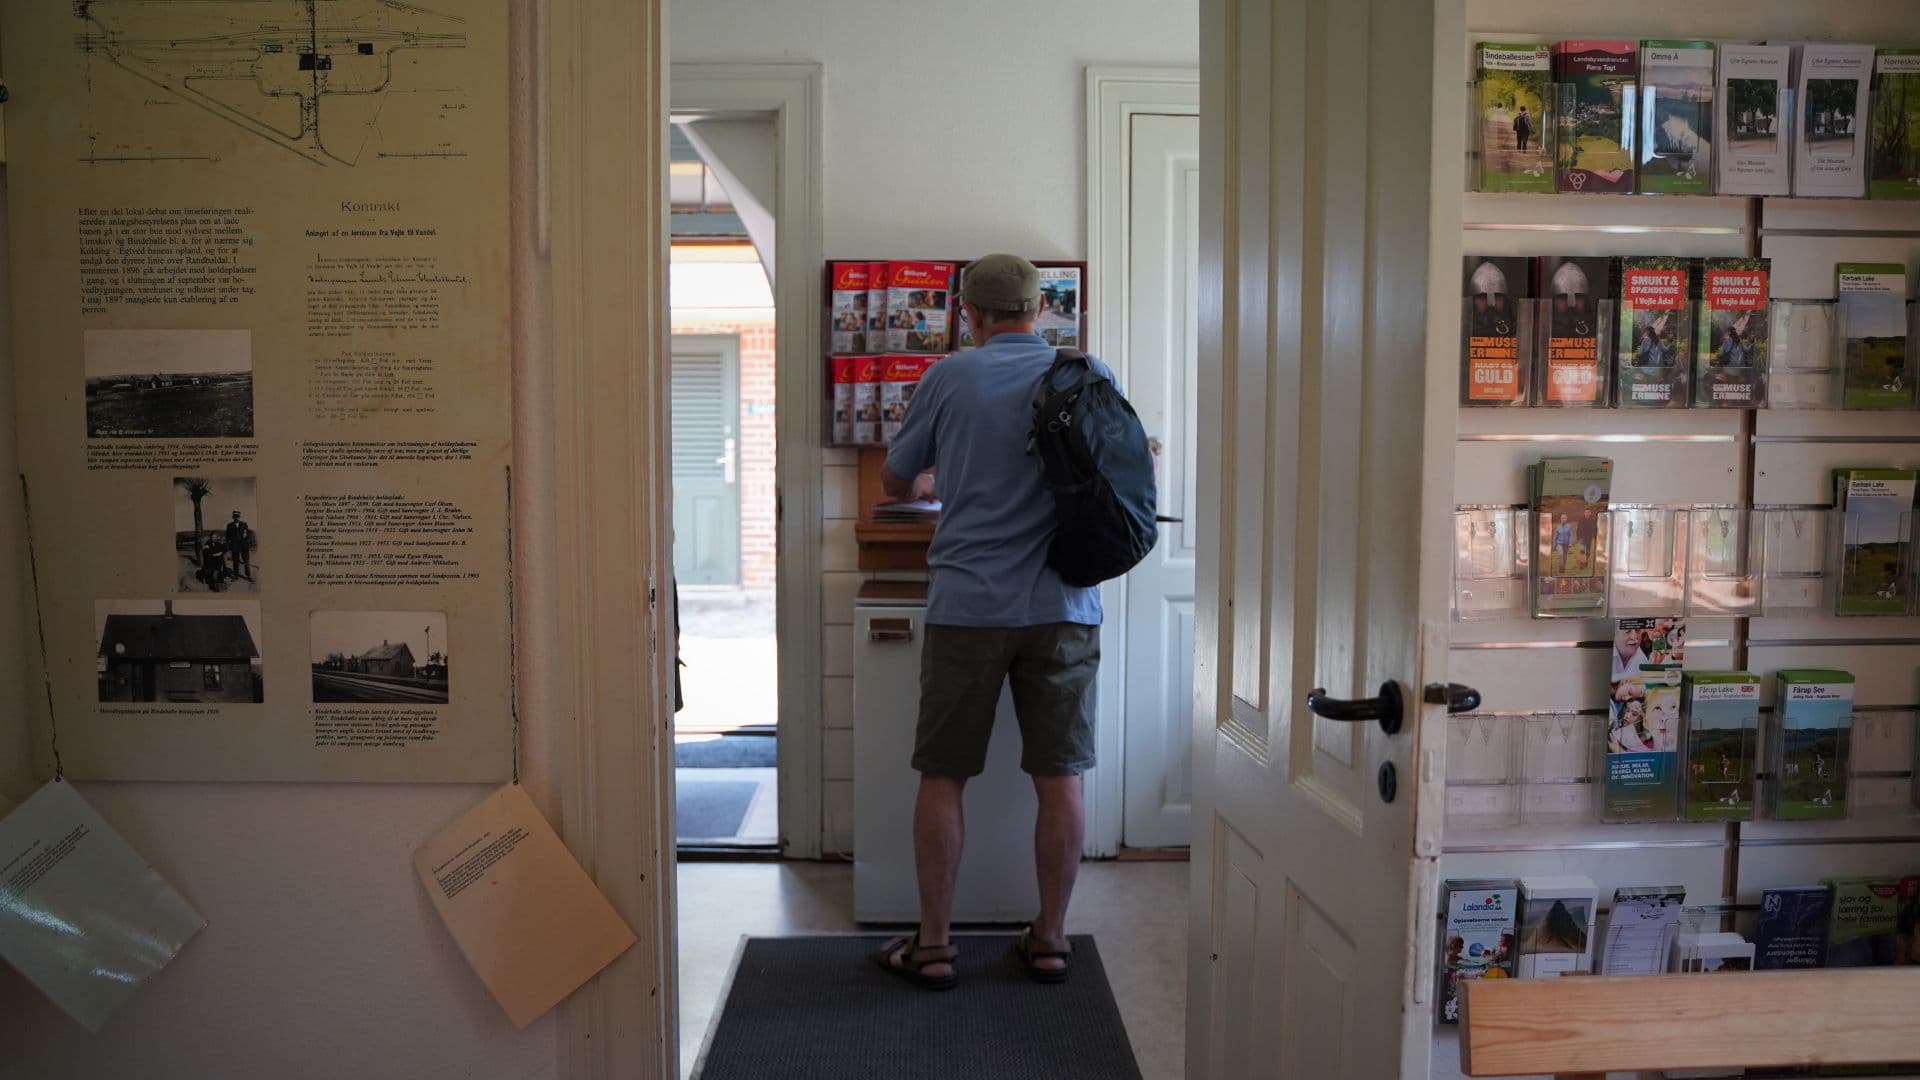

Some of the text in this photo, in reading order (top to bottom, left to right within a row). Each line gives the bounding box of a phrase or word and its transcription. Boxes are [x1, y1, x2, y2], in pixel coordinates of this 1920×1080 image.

[341, 201, 400, 212] Kontrakt
[904, 270, 928, 278] Billund
[1040, 271, 1077, 279] ELLING
[1631, 275, 1679, 285] SMUKT &
[1712, 276, 1761, 286] SMUKT &
[1712, 287, 1761, 295] SPÆNDENDE
[1475, 370, 1513, 384] GULD
[1552, 370, 1593, 385] GULD
[1699, 686, 1717, 694] Fårup
[1793, 686, 1812, 694] Fårup
[1858, 896, 1872, 904] og
[1463, 903, 1495, 911] Lalandia
